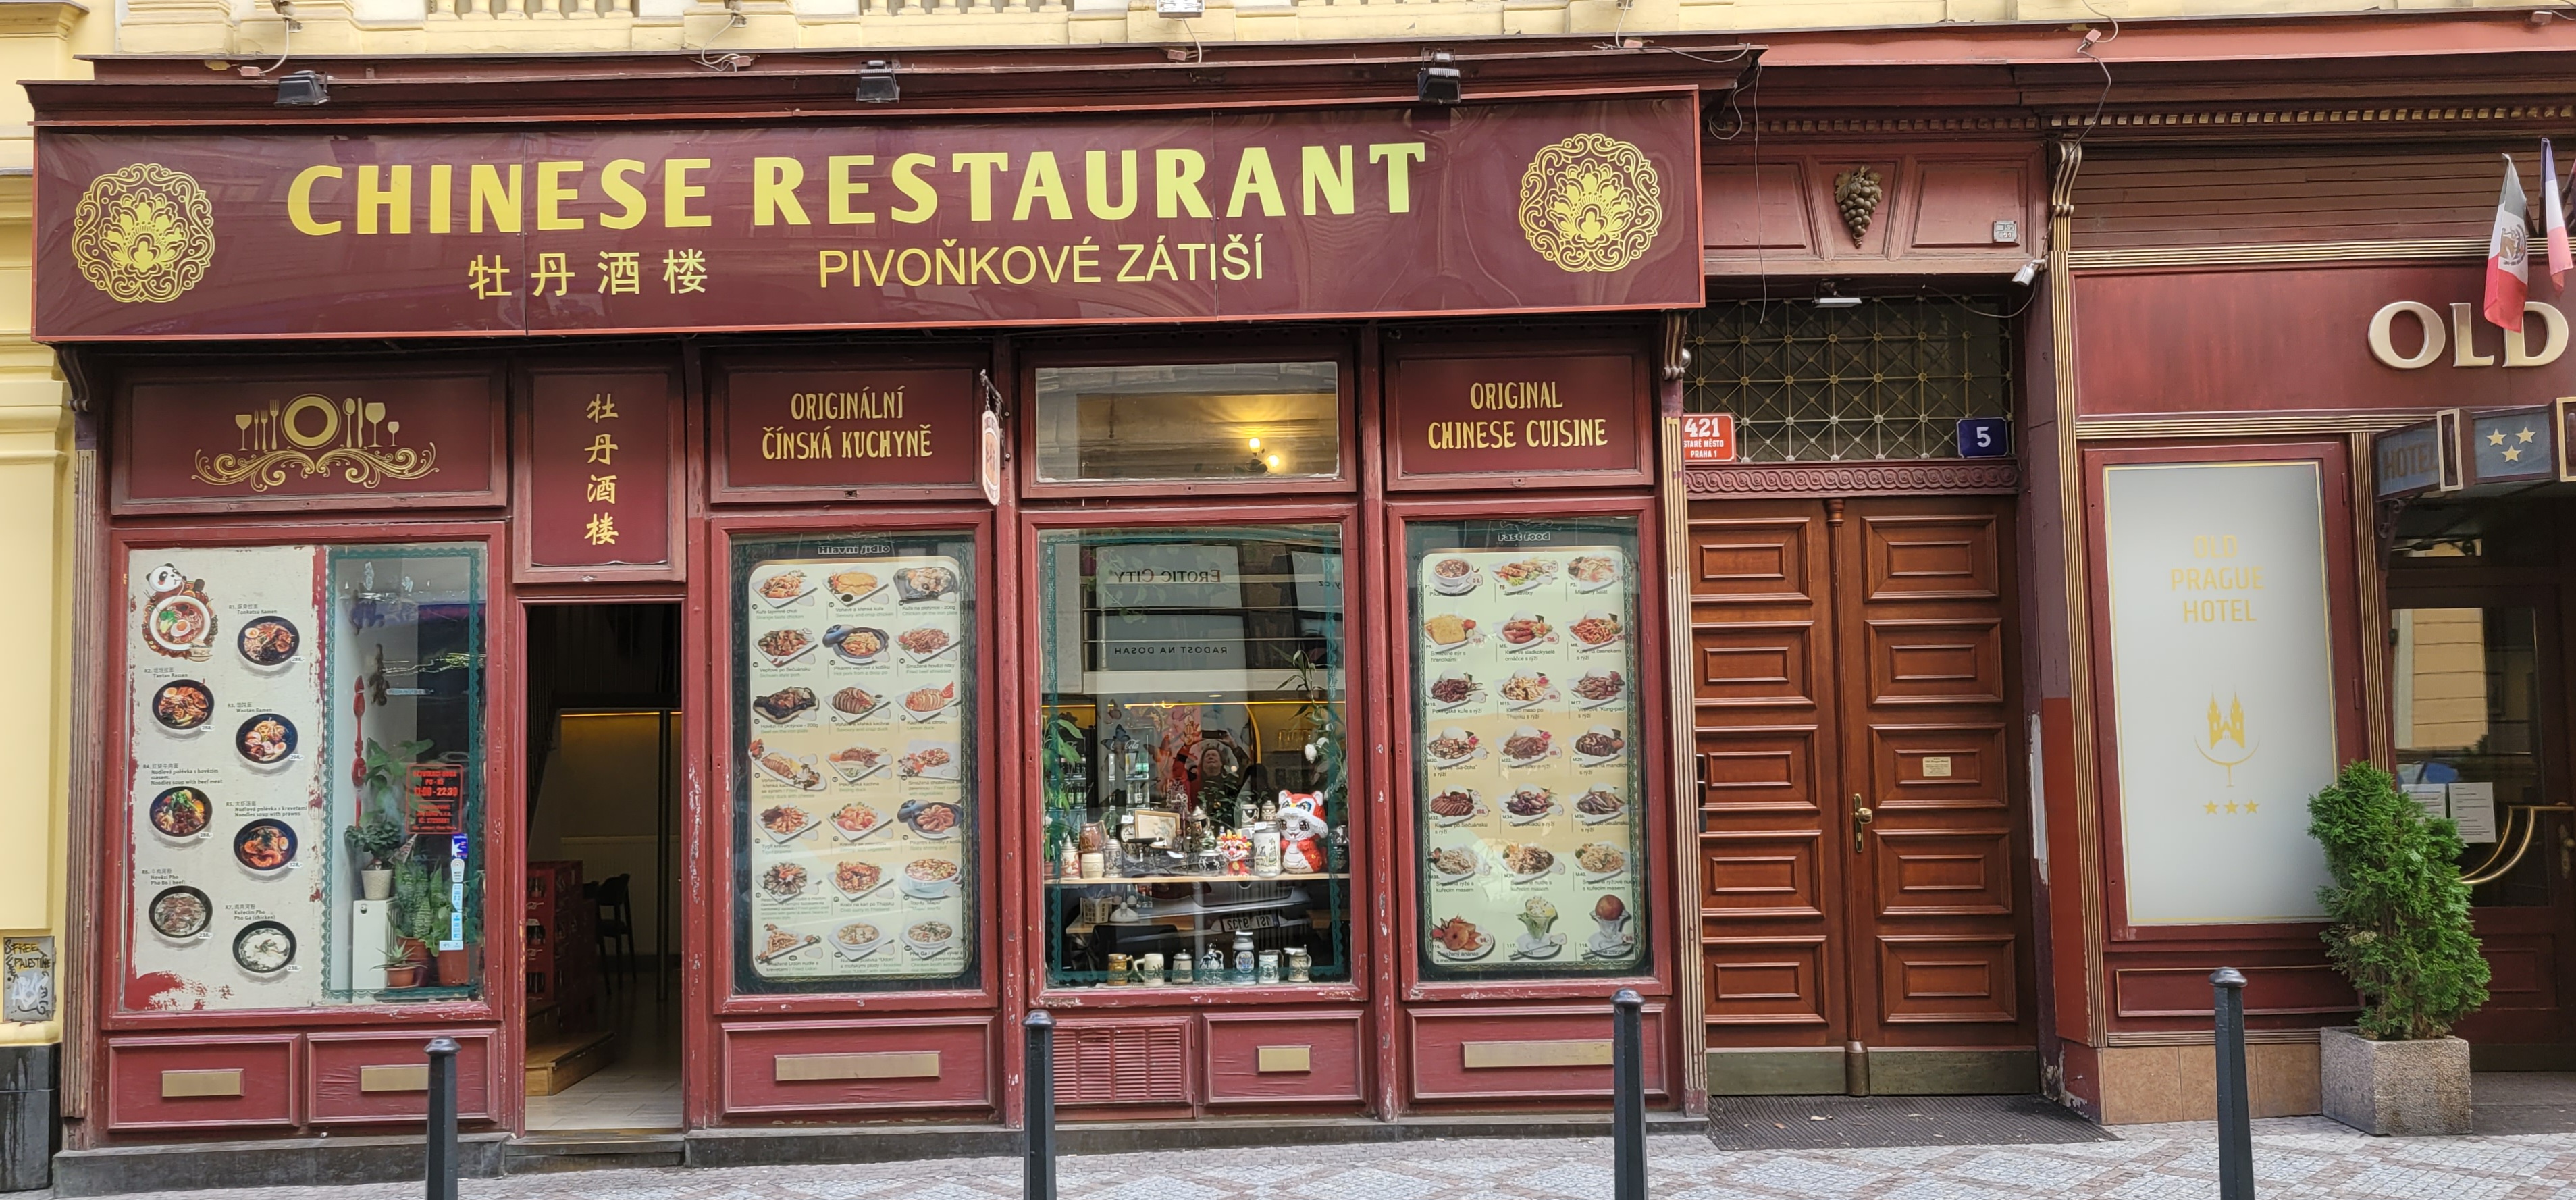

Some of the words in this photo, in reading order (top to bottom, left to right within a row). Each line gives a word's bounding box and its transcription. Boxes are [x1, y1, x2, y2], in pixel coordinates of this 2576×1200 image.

[287, 158, 712, 236] CHINESE
[753, 142, 1425, 226] RESTAURANT
[468, 248, 708, 300] 牡丹酒楼
[819, 237, 1101, 288] PIVOŇKOVÉ
[1116, 232, 1265, 283] ZÁTIŠÍ
[2367, 300, 2569, 369] OLD
[790, 385, 905, 421] ORIGINÁLNÍ
[1469, 380, 1563, 411] ORIGINAL
[762, 425, 833, 461] ČÍNSKÁ
[841, 424, 933, 458] KUCHYNĚ
[1427, 420, 1517, 450] CHINESE
[1525, 418, 1608, 448] CUISINE
[1683, 438, 1702, 448] STARÉ
[1703, 438, 1724, 448] MĚSTO
[1684, 417, 1720, 438] 421
[1976, 426, 1991, 448] 5
[584, 392, 619, 546] 牡丹酒楼
[2384, 442, 2437, 481] HOTEL
[1498, 532, 1523, 542] Fast
[2193, 534, 2237, 559] OLD
[2170, 566, 2265, 591] PRAGUE
[2182, 599, 2257, 623] HOTEL
[12, 943, 38, 954] FREE
[14, 957, 51, 968] PALESTINE
